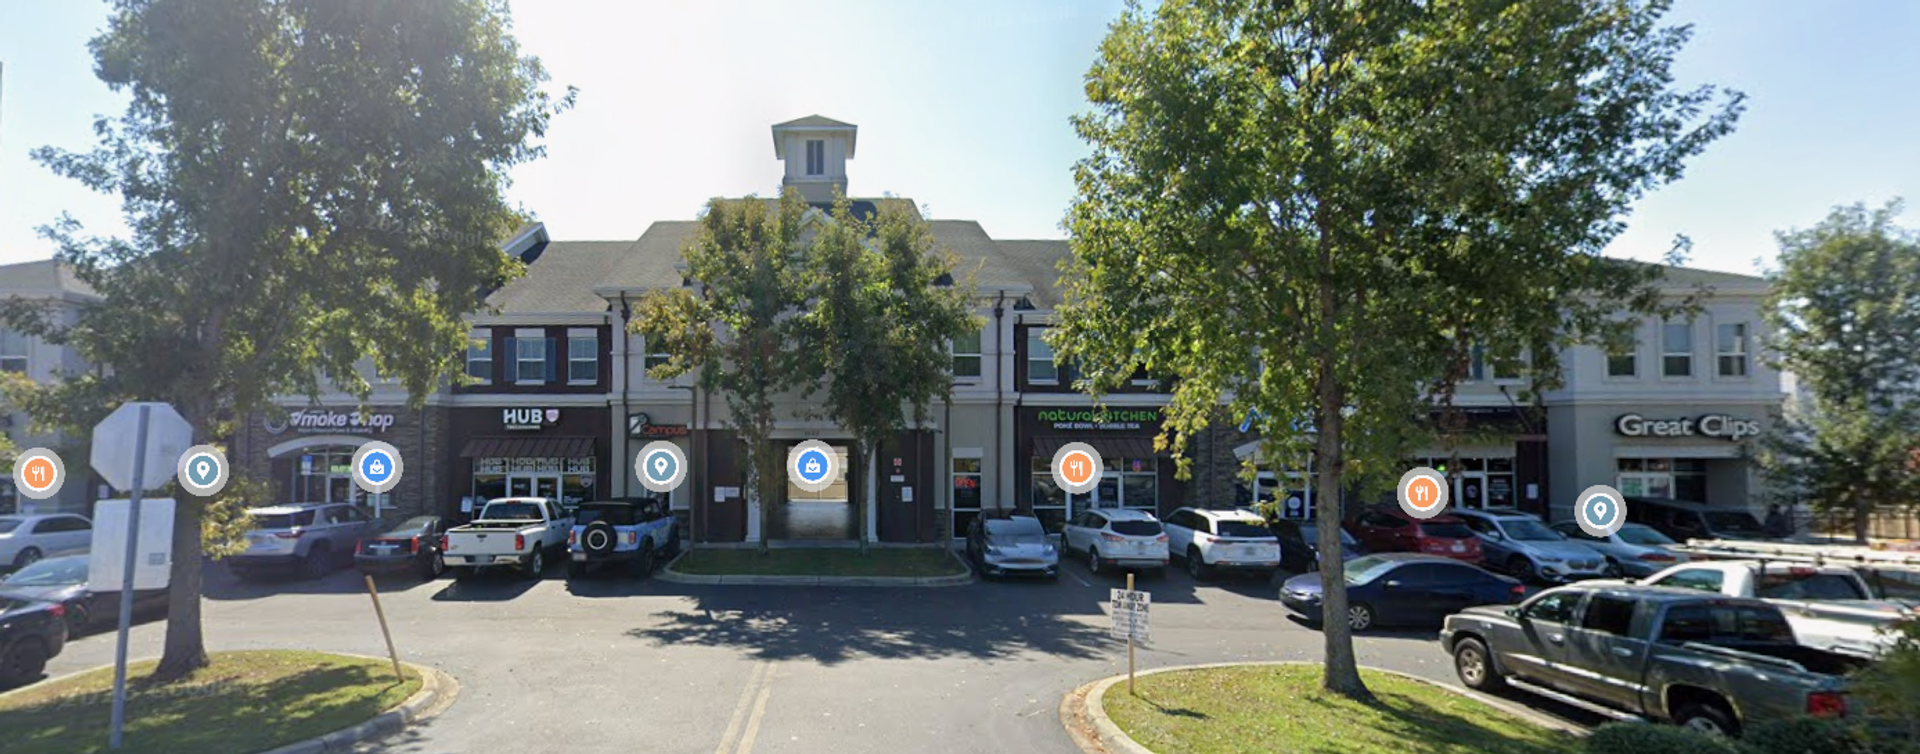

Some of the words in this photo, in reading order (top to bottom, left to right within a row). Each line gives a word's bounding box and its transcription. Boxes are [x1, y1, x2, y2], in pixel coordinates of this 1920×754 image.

[503, 408, 543, 424] HUB
[642, 424, 688, 437] Campus
[1053, 421, 1073, 429] POKÉ
[1619, 414, 1693, 436] Great
[1700, 415, 1760, 441] Clips
[1116, 590, 1125, 600] 24
[1126, 592, 1145, 602] HOUR
